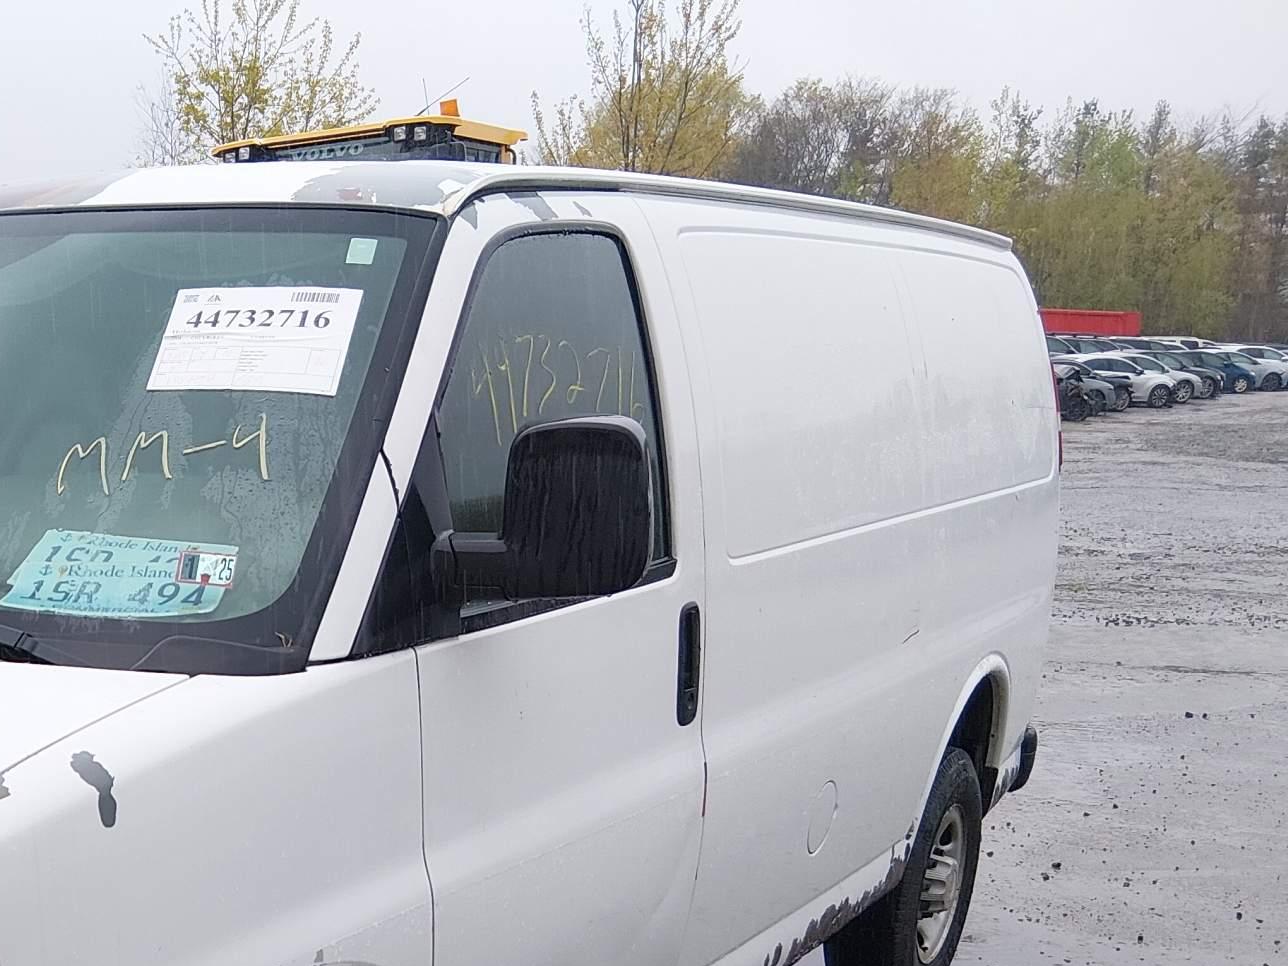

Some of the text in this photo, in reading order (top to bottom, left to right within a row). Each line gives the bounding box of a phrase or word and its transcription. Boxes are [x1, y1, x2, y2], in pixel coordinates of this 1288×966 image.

[291, 143, 365, 161] VOLVO
[186, 309, 332, 329] 44732716
[68, 565, 124, 578] Rhode
[218, 557, 235, 582] 25
[127, 581, 204, 607] 494
